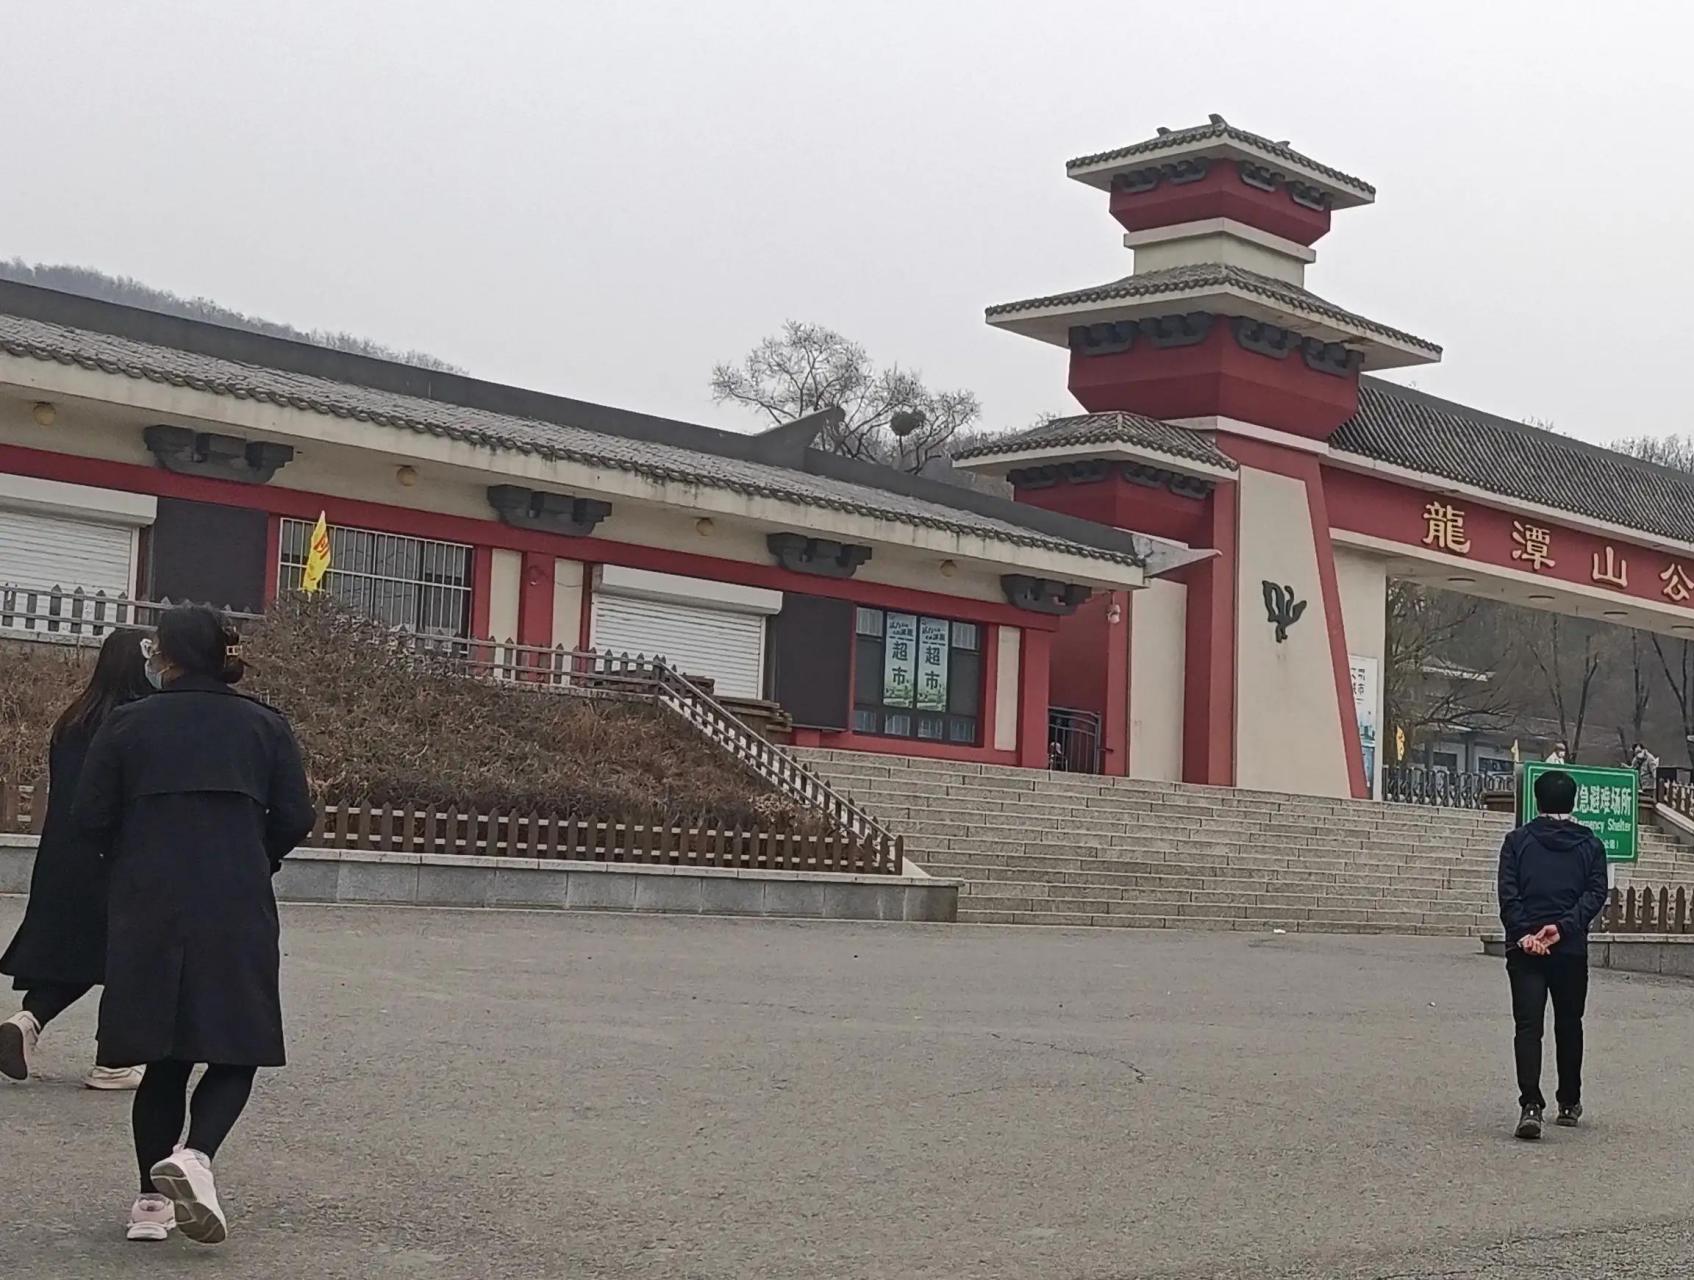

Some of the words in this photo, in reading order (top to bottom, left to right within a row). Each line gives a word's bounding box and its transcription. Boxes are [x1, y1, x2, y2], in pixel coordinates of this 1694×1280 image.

[892, 642, 908, 686] 超市
[925, 647, 940, 690] 超市
[1608, 819, 1631, 831] Shelter
